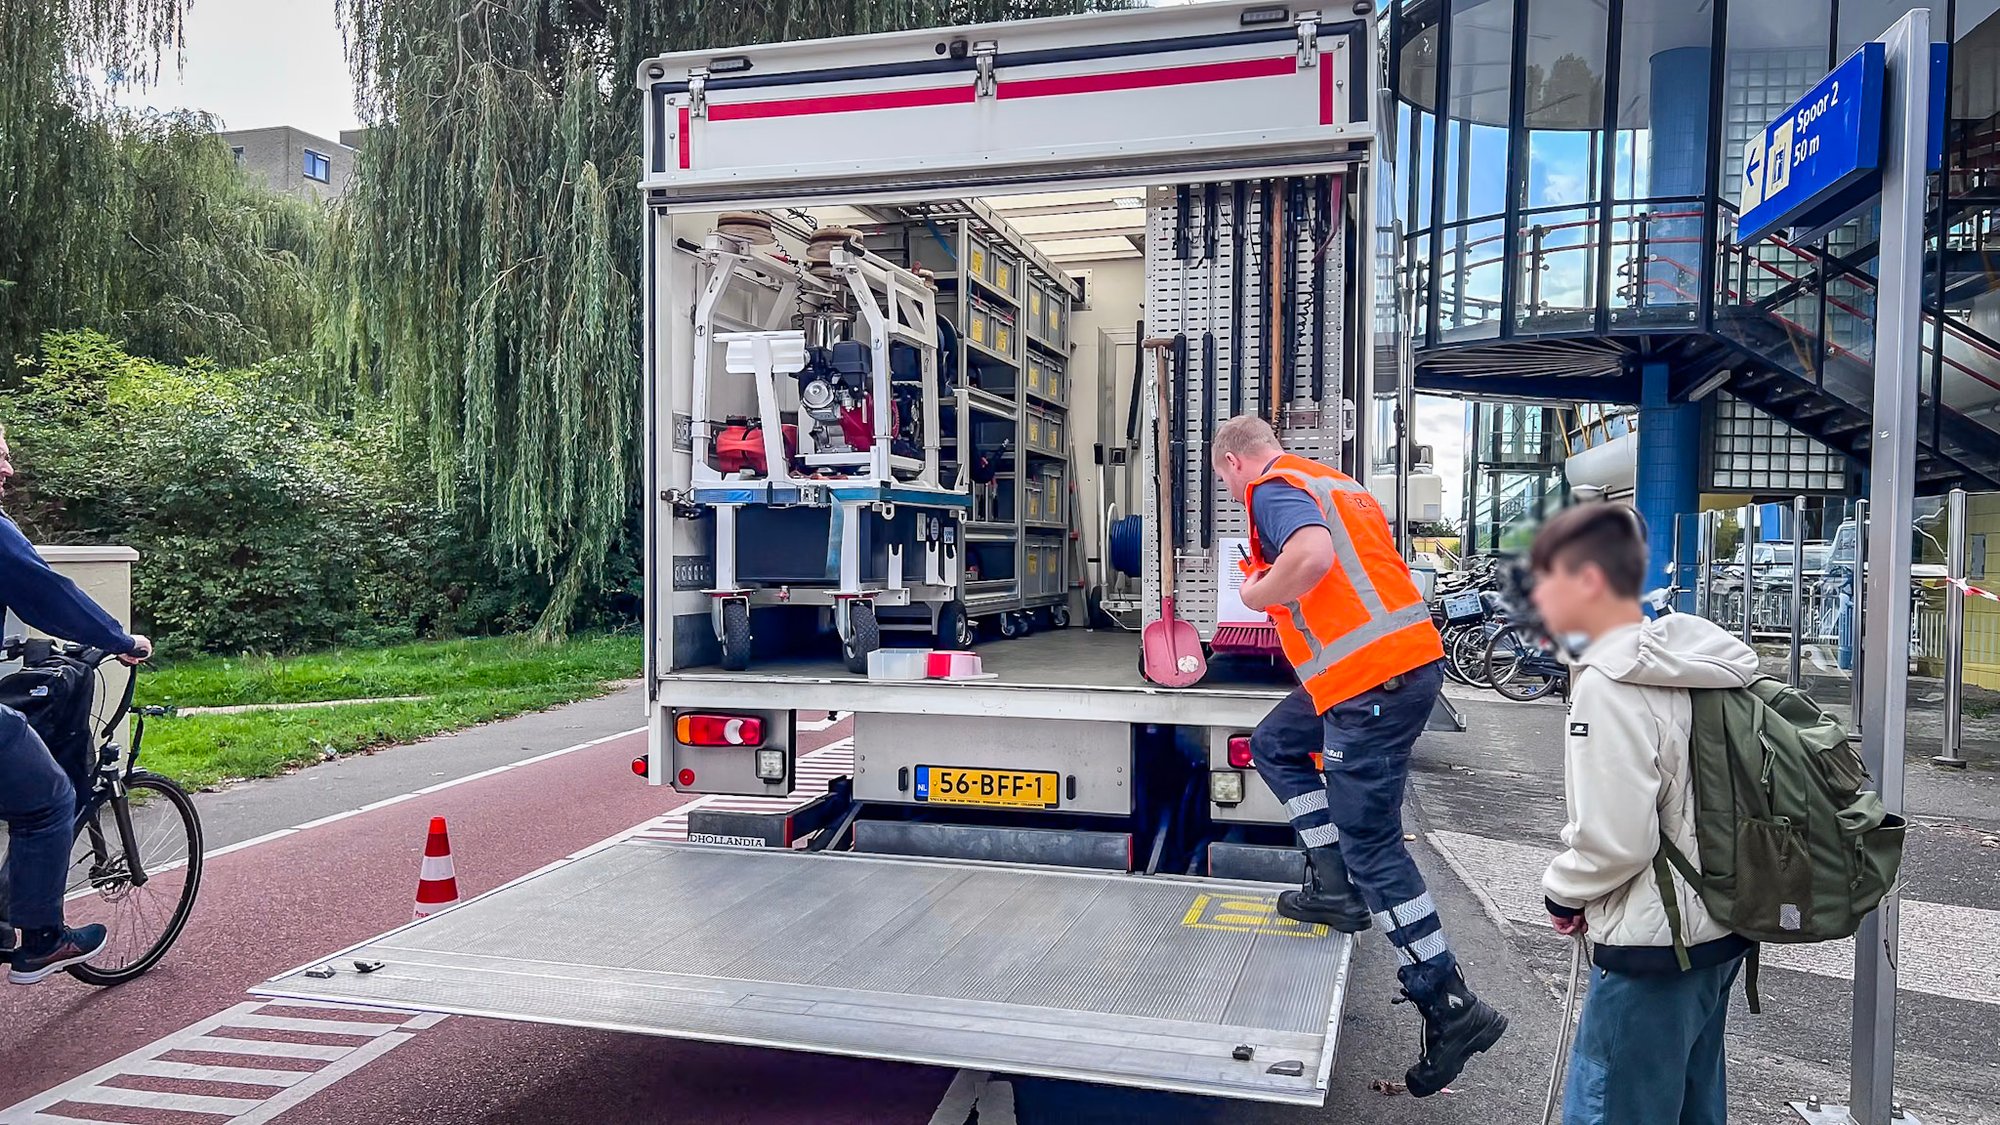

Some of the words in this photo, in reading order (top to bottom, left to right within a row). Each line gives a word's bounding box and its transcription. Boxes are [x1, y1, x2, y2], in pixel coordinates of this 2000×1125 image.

[1796, 93, 1829, 134] Spoor
[1831, 81, 1839, 107] 2
[1793, 139, 1808, 167] 50
[1809, 134, 1820, 156] m
[940, 772, 1042, 798] 56-BFF-1
[690, 834, 763, 847] DHOLLANDIA
